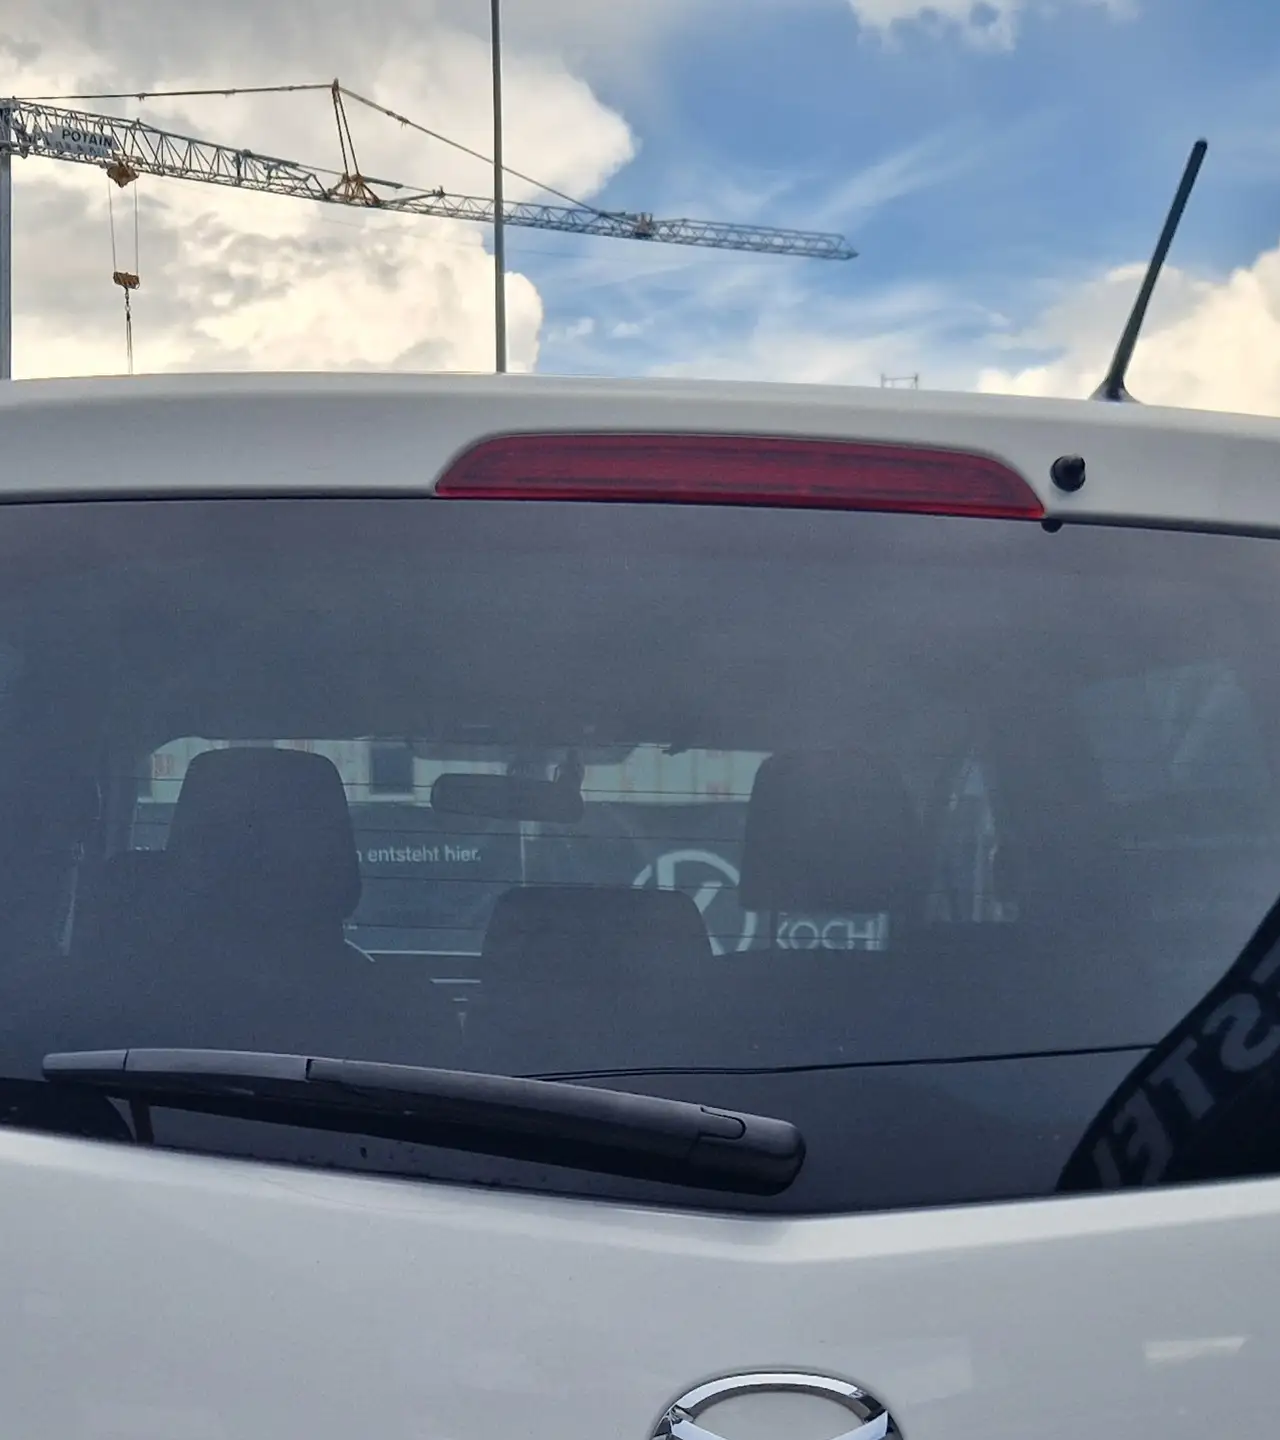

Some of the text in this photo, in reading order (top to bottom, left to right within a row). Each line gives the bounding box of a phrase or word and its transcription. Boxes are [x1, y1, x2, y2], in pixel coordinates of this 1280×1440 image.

[62, 129, 112, 147] POTAIN
[368, 845, 439, 863] entsteht
[445, 844, 481, 862] hier.
